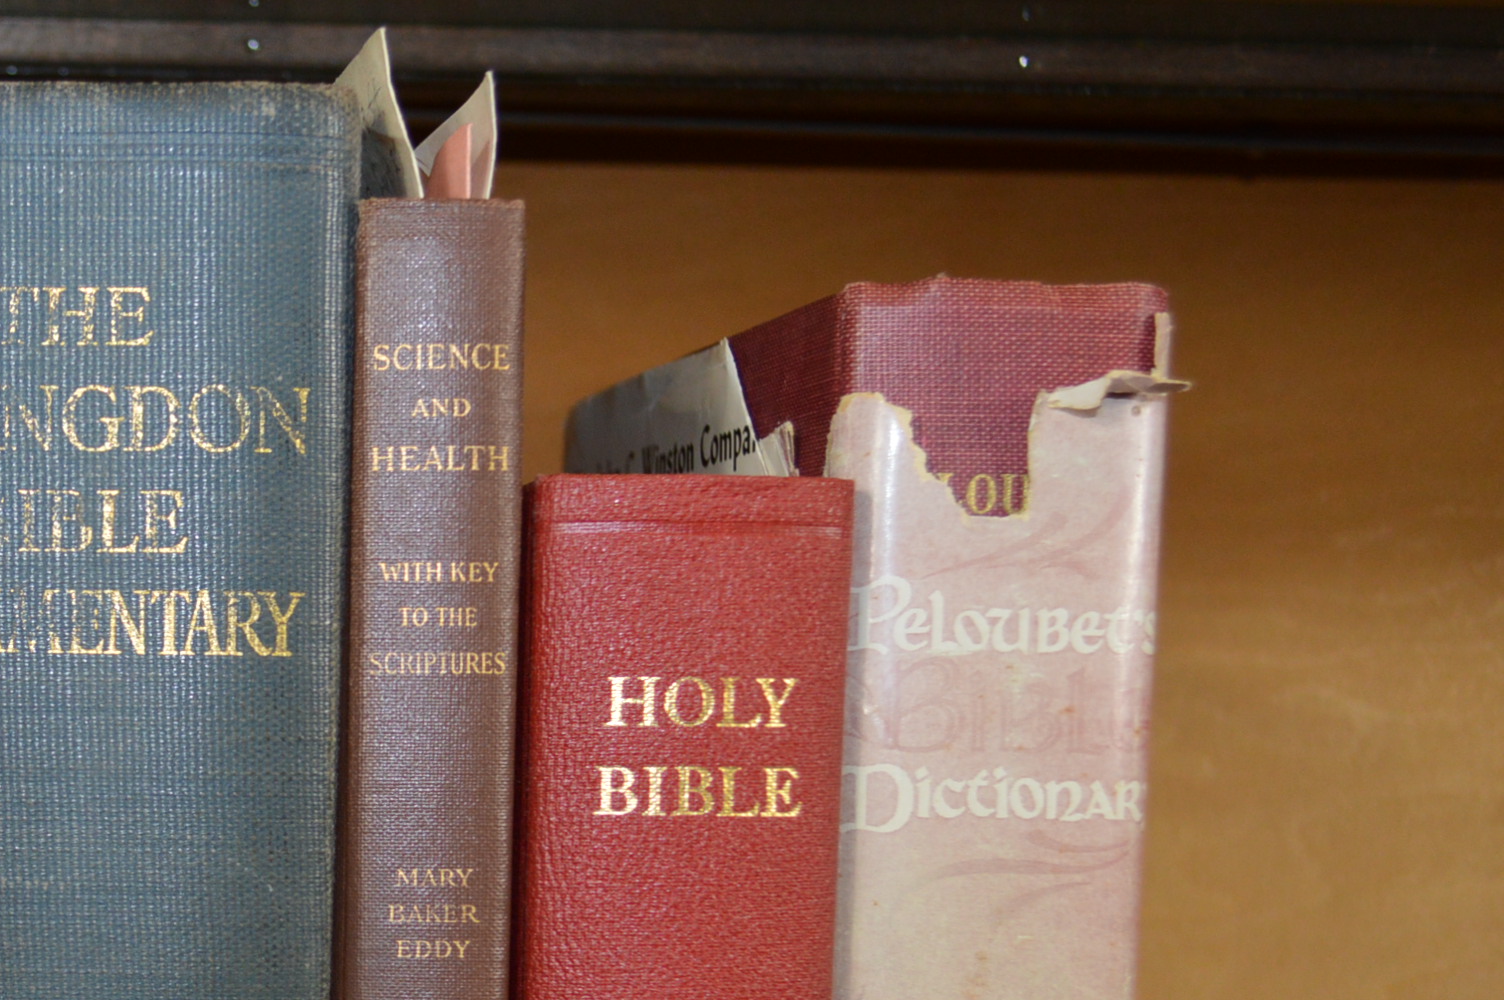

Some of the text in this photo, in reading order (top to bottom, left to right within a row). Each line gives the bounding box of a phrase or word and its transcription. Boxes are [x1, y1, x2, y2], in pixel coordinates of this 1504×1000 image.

[373, 343, 510, 371] SCIENCE
[411, 398, 472, 418] AND
[371, 445, 510, 472] HEALTH
[641, 441, 695, 474] Winston
[700, 424, 756, 472] Compa
[378, 562, 499, 584] WITH KEY
[400, 607, 478, 627] TO THE
[369, 651, 507, 675] SCRIPTURES
[604, 675, 799, 728] HOLY
[593, 764, 802, 817] BIBLE
[840, 763, 1144, 834] Dictionar
[396, 867, 474, 887] MARY
[389, 904, 480, 923] BAKER
[397, 939, 471, 958] EDDY
